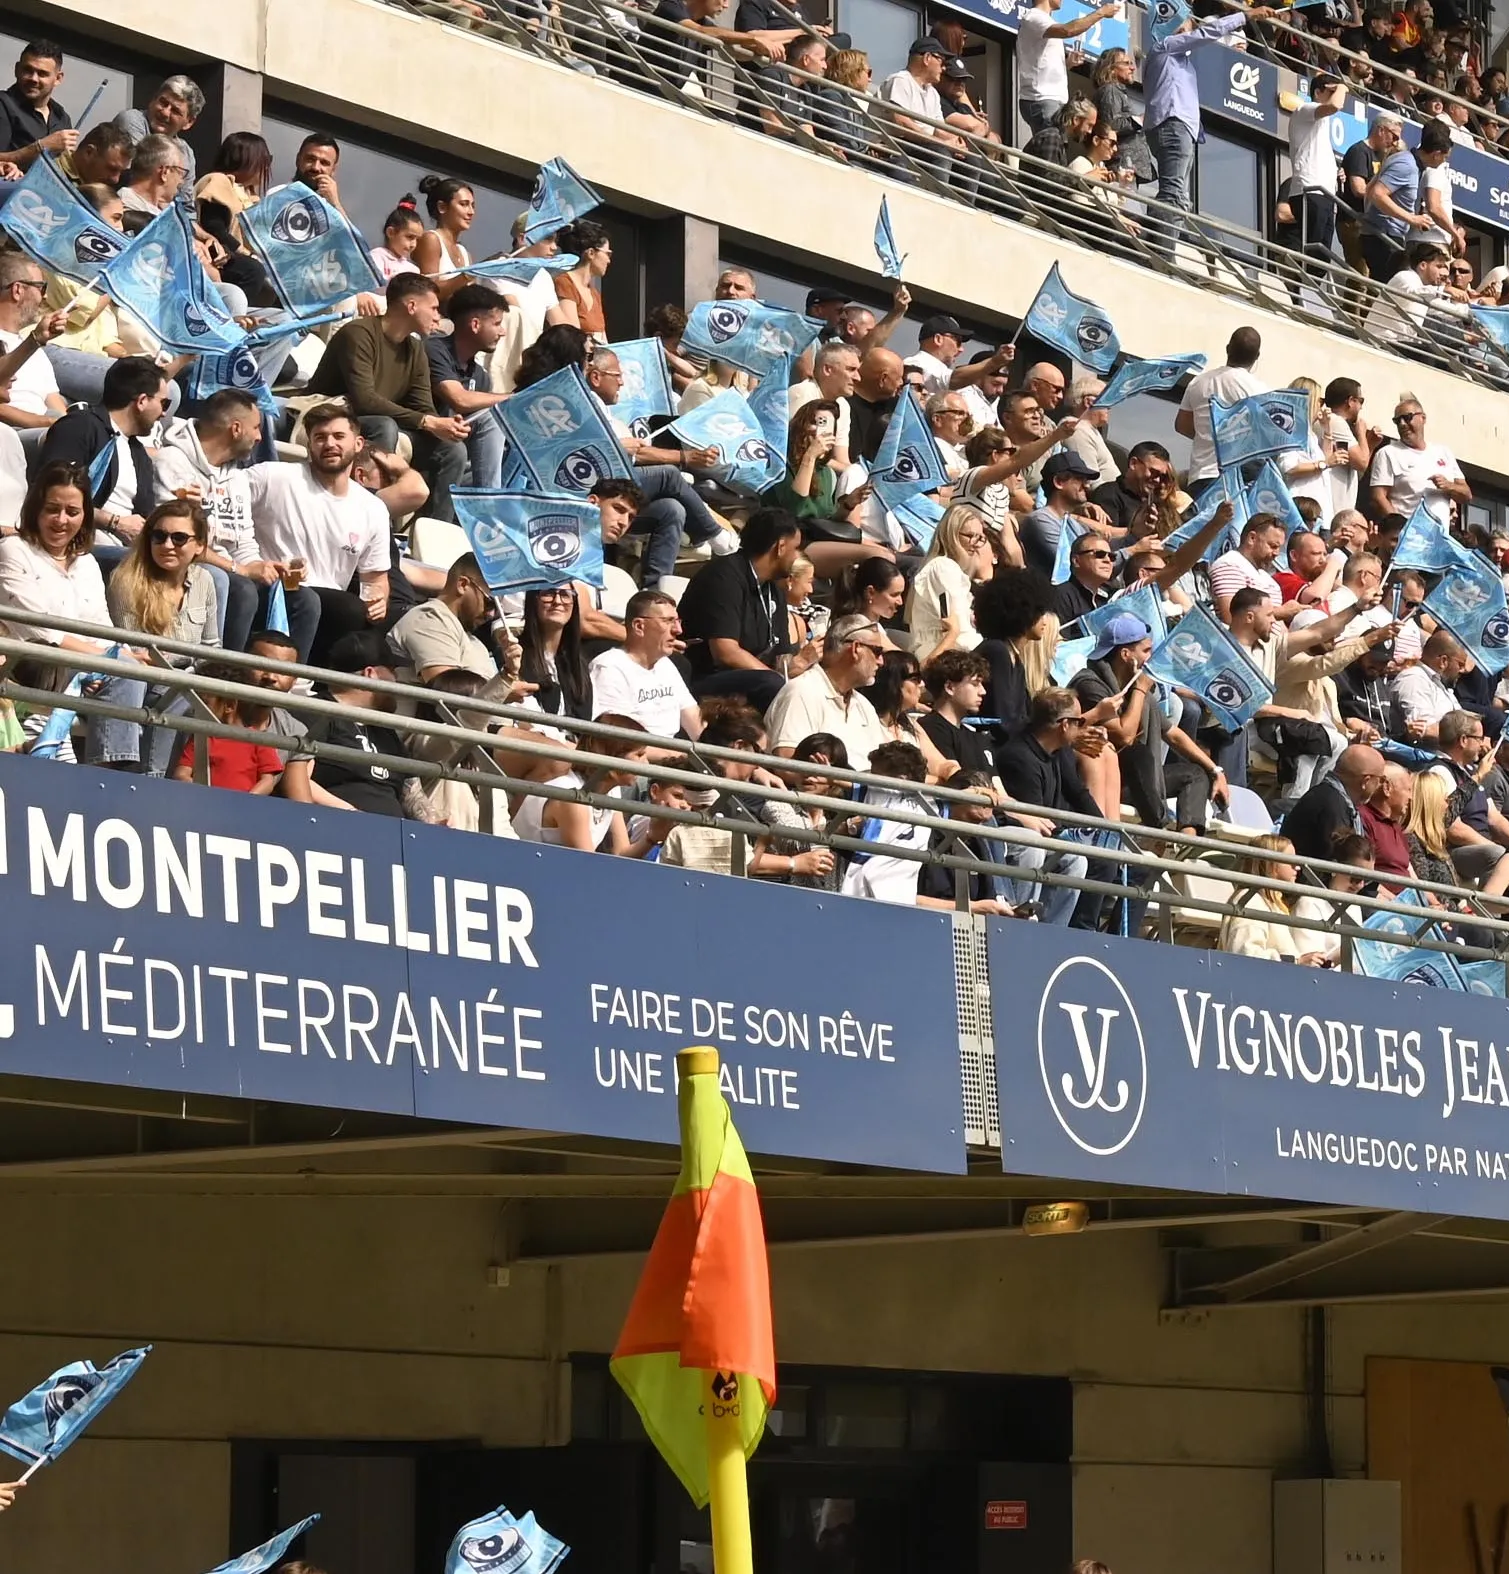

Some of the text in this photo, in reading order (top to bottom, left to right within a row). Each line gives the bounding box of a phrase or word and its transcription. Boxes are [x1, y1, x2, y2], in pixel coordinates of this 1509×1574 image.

[1223, 98, 1265, 122] LANGUEDOC
[27, 805, 540, 969] MONTPELLIER
[35, 937, 546, 1082] MÉDITERRANÉE
[590, 983, 896, 1063] FAIRE DE SON RÊVE
[1172, 987, 1426, 1099] VIGNOBLES
[594, 1046, 665, 1094] UNE
[1275, 1126, 1420, 1173] LANGUEDOC
[1423, 1140, 1468, 1177] PAR
